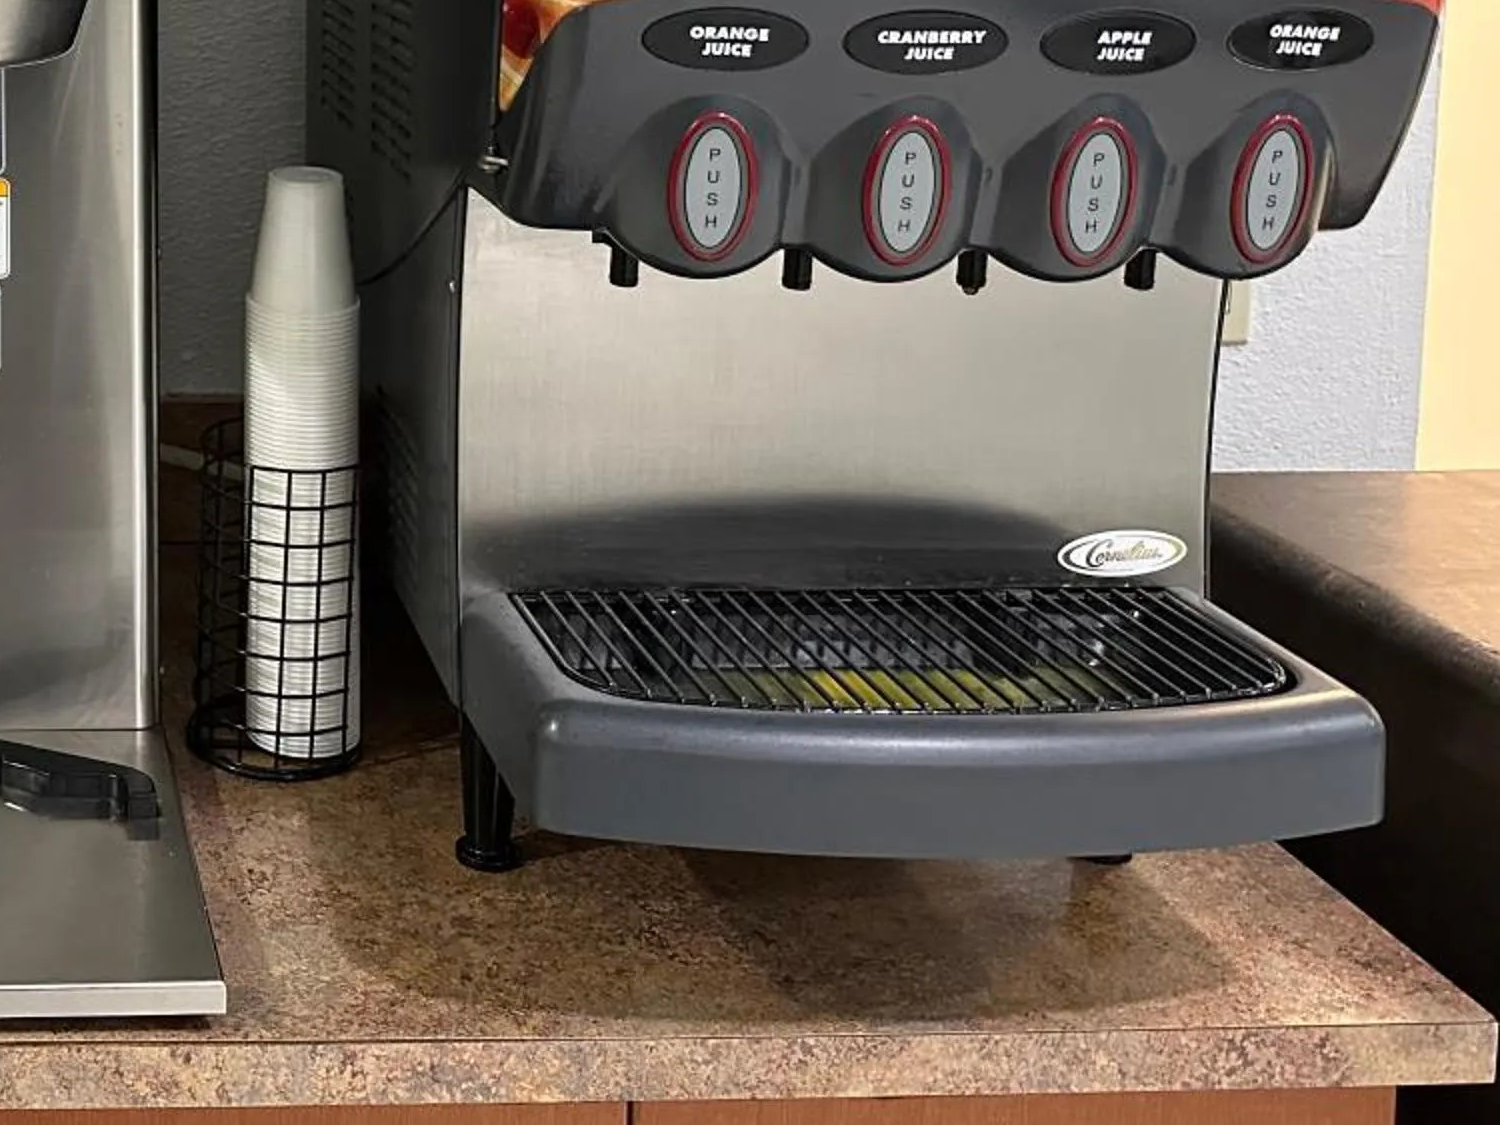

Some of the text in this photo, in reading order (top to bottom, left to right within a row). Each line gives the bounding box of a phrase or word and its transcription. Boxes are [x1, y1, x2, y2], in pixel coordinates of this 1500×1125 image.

[689, 26, 771, 42] ORANGE
[877, 30, 987, 44] CRANBERRY
[1097, 30, 1152, 46] APPLE
[1269, 24, 1341, 42] ORANGE
[701, 43, 752, 58] JUICE
[904, 46, 955, 61] JUICE
[1096, 46, 1146, 62] JUICE
[1275, 41, 1322, 57] JUICE
[704, 148, 722, 228] PUSH
[897, 151, 917, 233] PUSH
[1084, 153, 1106, 234] PUSH
[1261, 150, 1284, 231] PUSH
